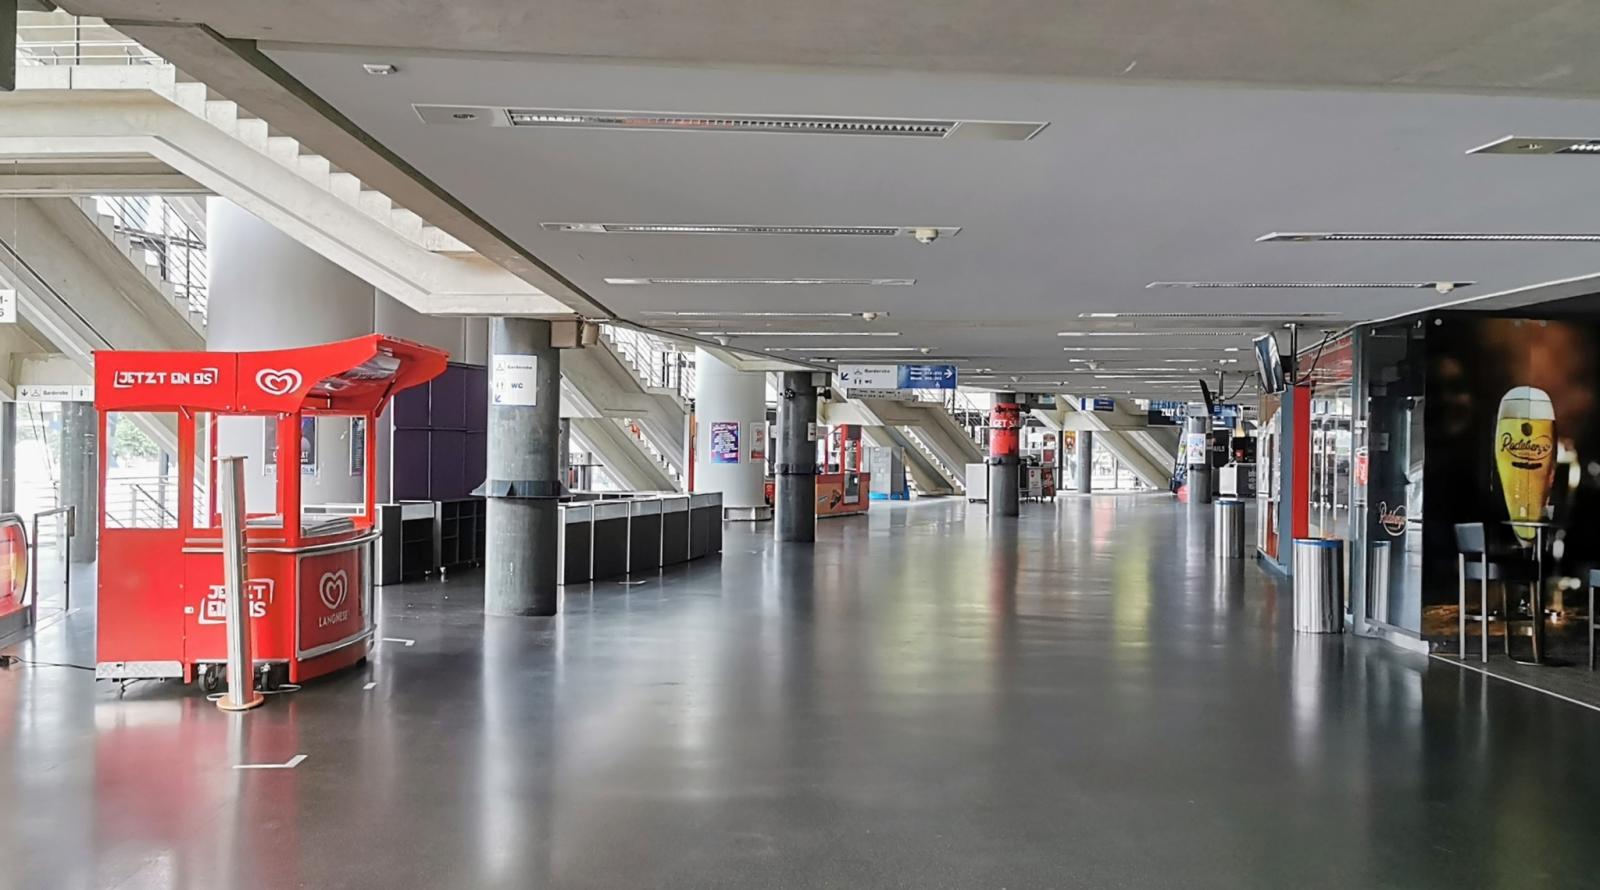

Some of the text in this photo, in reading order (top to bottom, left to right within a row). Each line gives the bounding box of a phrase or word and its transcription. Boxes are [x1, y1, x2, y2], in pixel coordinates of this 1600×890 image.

[118, 371, 213, 386] JETZT EIN EIS
